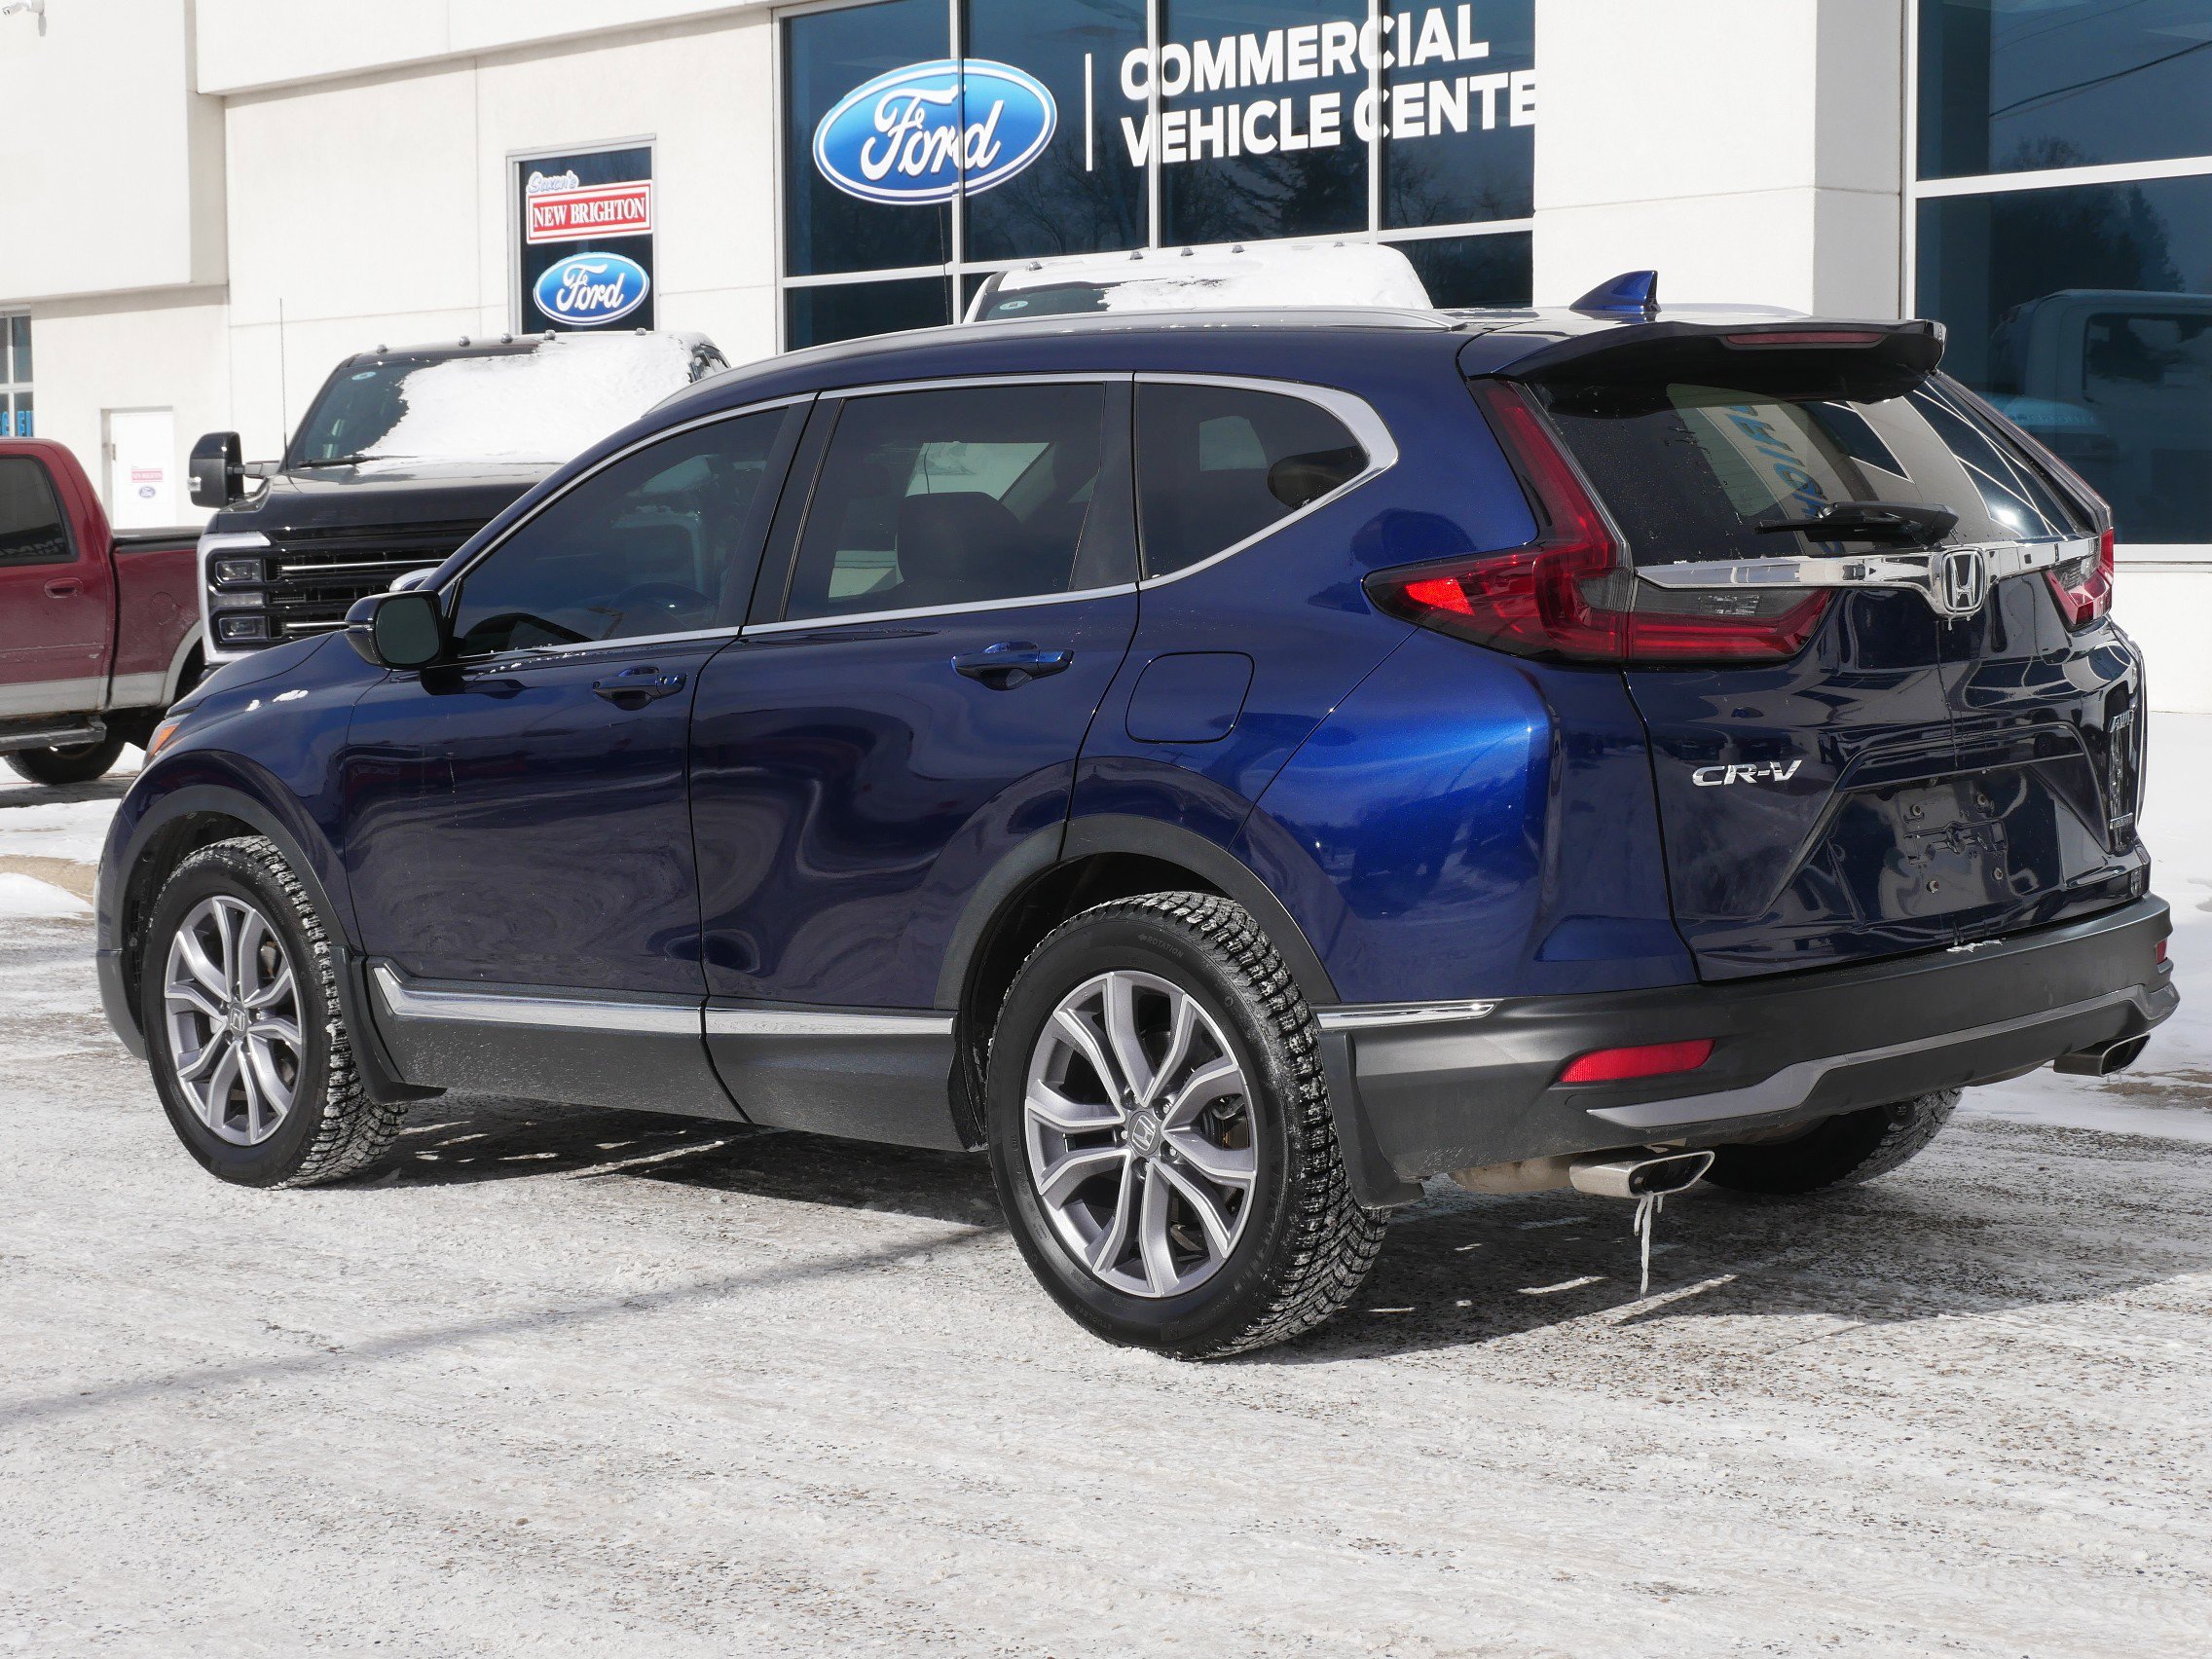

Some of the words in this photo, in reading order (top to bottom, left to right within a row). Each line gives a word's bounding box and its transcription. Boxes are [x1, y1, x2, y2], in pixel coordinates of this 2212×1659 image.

[1121, 3, 1490, 101] COMMERCIAL
[861, 85, 1005, 181] Ford
[1121, 92, 1341, 167] VEHICLE
[533, 203, 569, 228] NEW
[571, 197, 645, 225] BRIGHTON
[556, 263, 626, 312] Ford
[1692, 759, 1802, 787] CR-V
[1146, 935, 1184, 958] ROTATION
